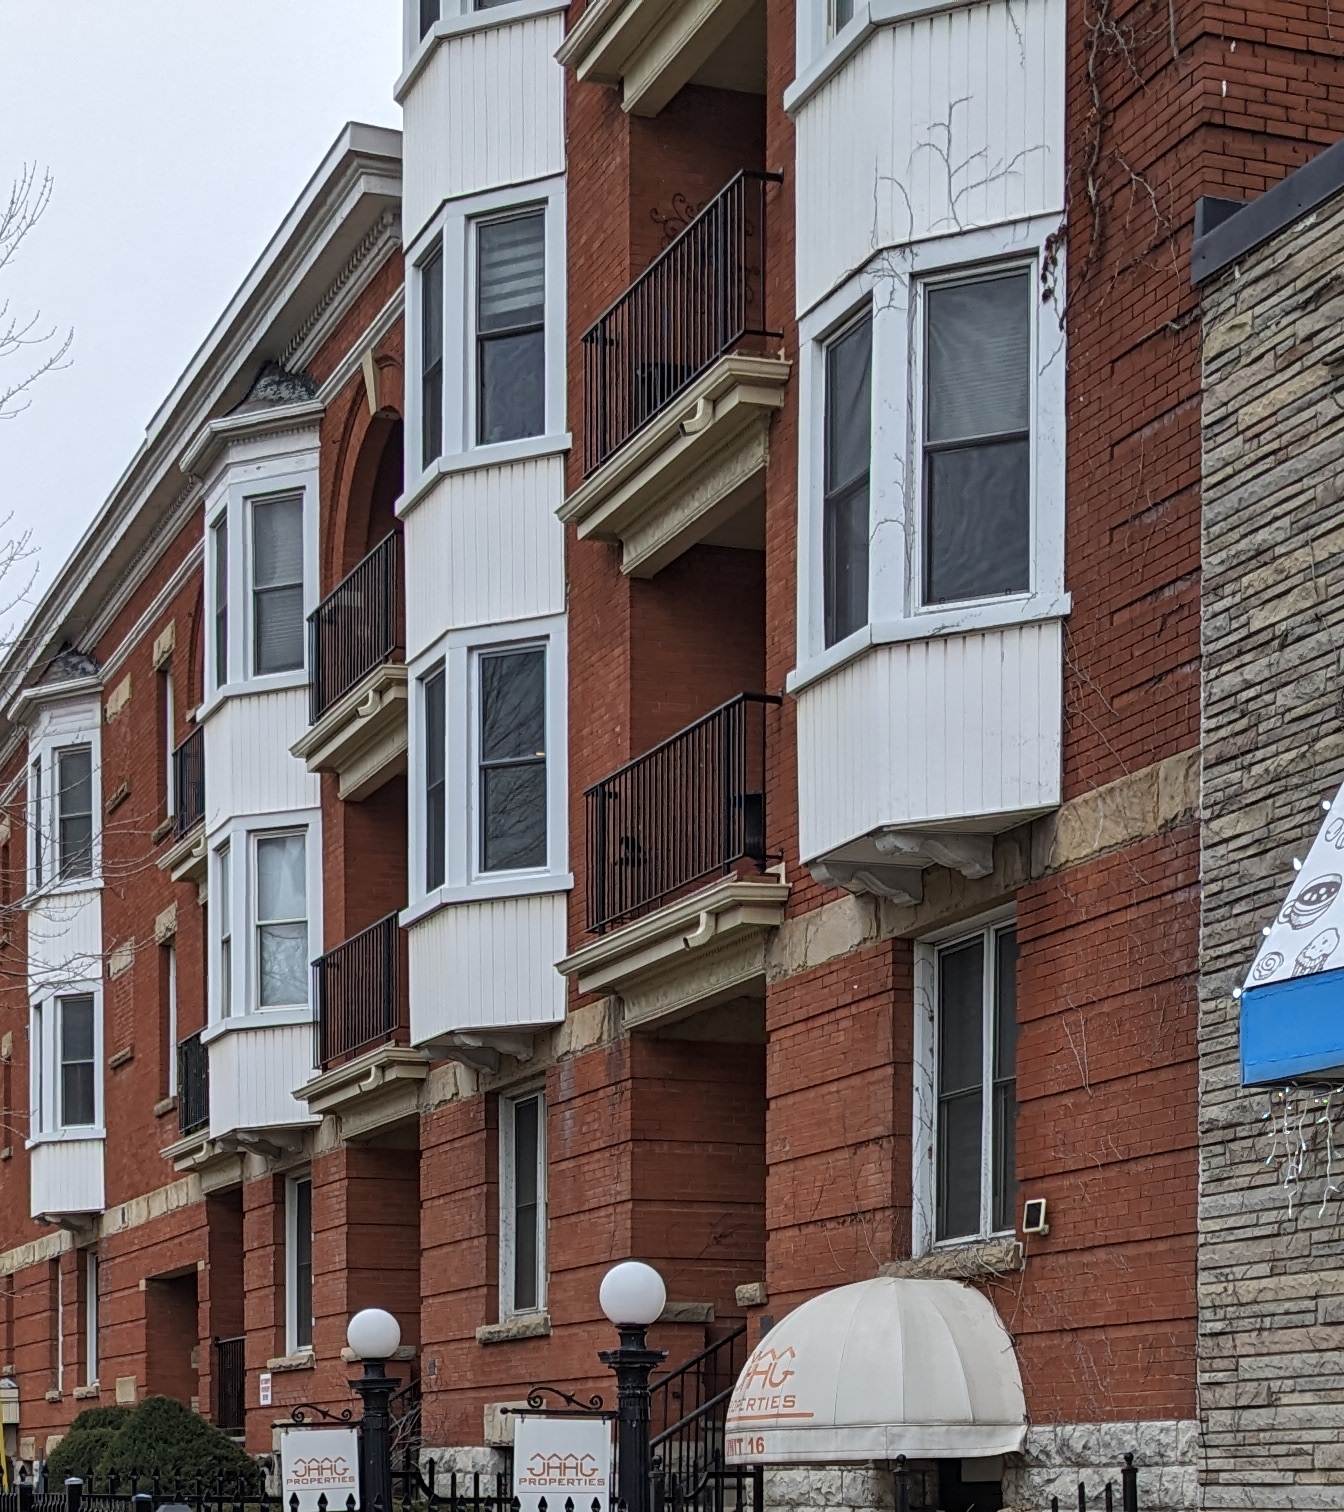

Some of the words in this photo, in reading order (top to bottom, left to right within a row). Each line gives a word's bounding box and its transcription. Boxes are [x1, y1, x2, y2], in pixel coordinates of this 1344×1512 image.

[747, 1436, 765, 1455] 16
[286, 1475, 356, 1485] PROPERTIES
[518, 1477, 606, 1487] PROPERTIES
